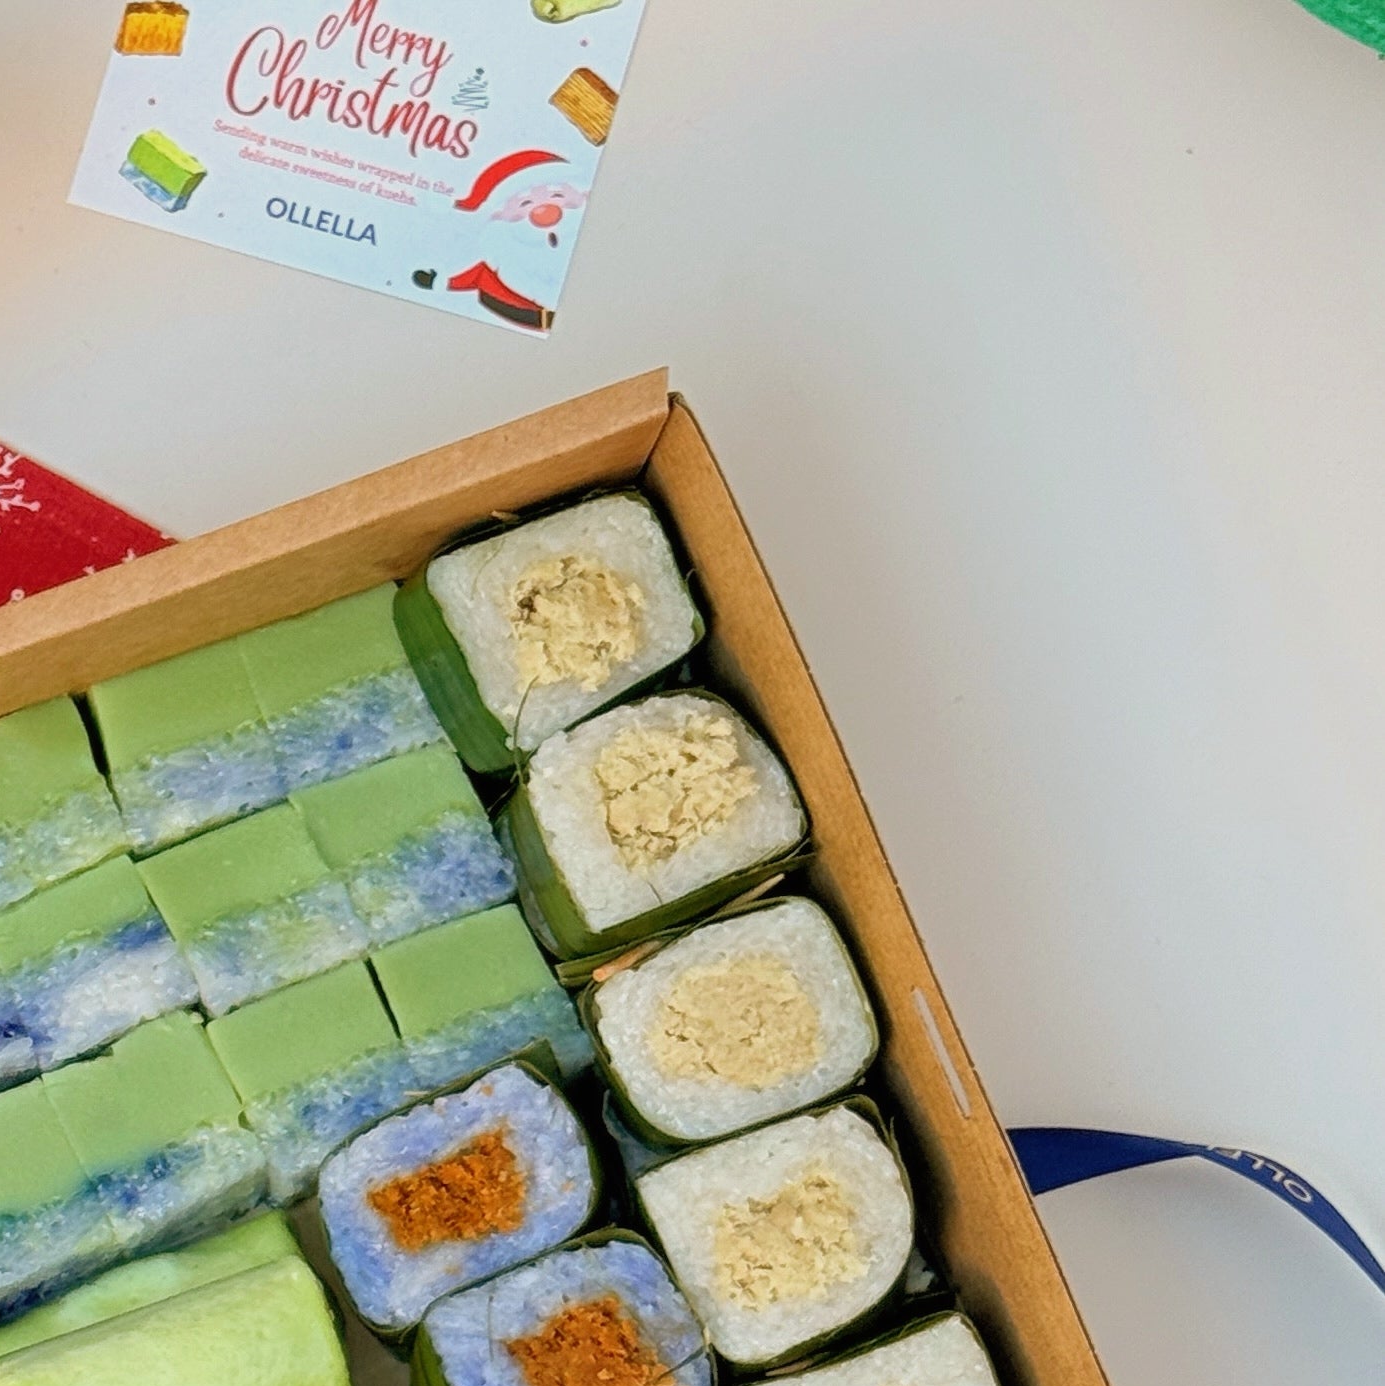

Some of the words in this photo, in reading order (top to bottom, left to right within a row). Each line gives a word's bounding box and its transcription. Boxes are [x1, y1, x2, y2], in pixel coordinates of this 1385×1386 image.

[316, 0, 454, 97] Merry
[226, 26, 478, 158] Christmas
[213, 119, 266, 146] Sending
[270, 137, 307, 156] warm
[311, 147, 354, 168] wishes
[357, 161, 414, 185] wrapped
[416, 177, 430, 190] in
[433, 180, 455, 195] the
[239, 147, 289, 172] delicate
[291, 164, 356, 189] sweetness
[358, 182, 374, 194] of
[266, 197, 377, 246] OLLELLA
